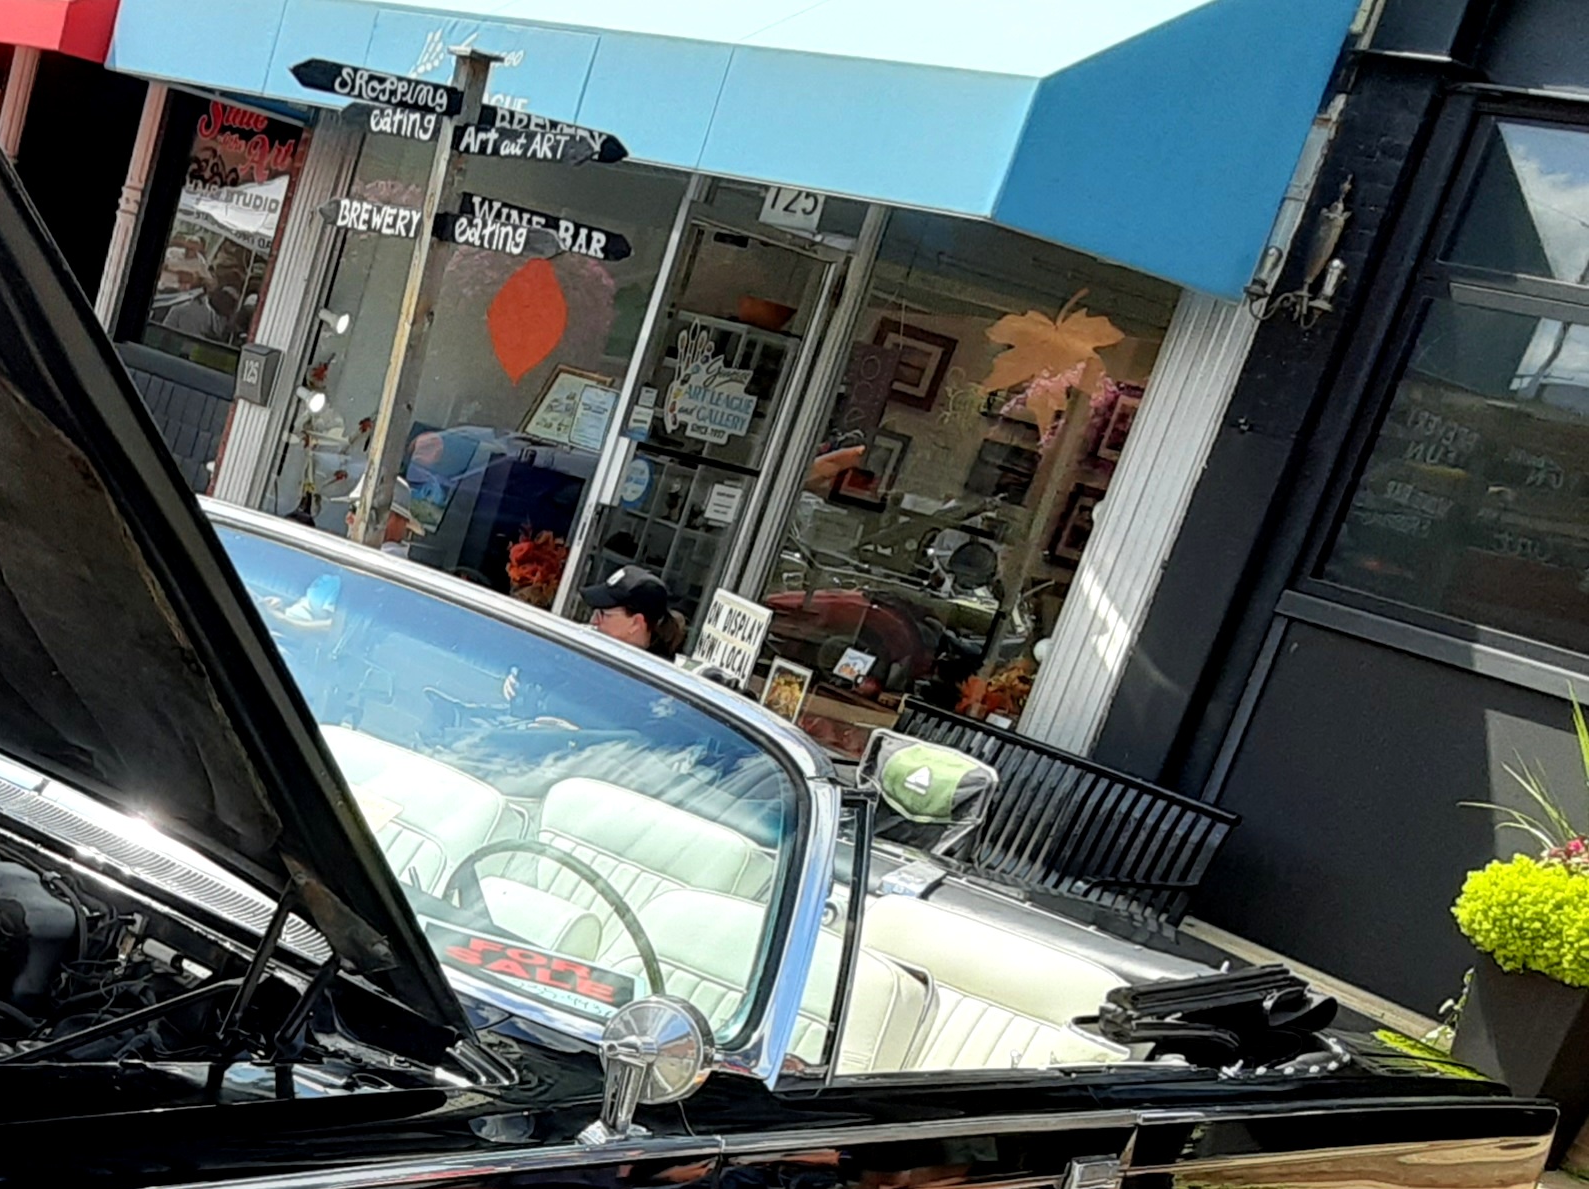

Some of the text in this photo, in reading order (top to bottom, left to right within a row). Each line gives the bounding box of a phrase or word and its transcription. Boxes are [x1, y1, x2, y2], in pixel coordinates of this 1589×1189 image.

[370, 108, 437, 141] eating
[459, 126, 499, 154] Art
[527, 133, 570, 159] ART
[336, 199, 422, 238] BREWERY
[455, 217, 528, 255] eating
[559, 219, 607, 258] BAR
[243, 360, 259, 384] 125
[686, 384, 754, 415] ART LEAGUE
[696, 406, 748, 431] GALLERY
[722, 608, 763, 647] DISPLAY
[719, 642, 751, 679] LOCAL
[446, 946, 615, 1002] SALE
[469, 937, 593, 980] FOR
